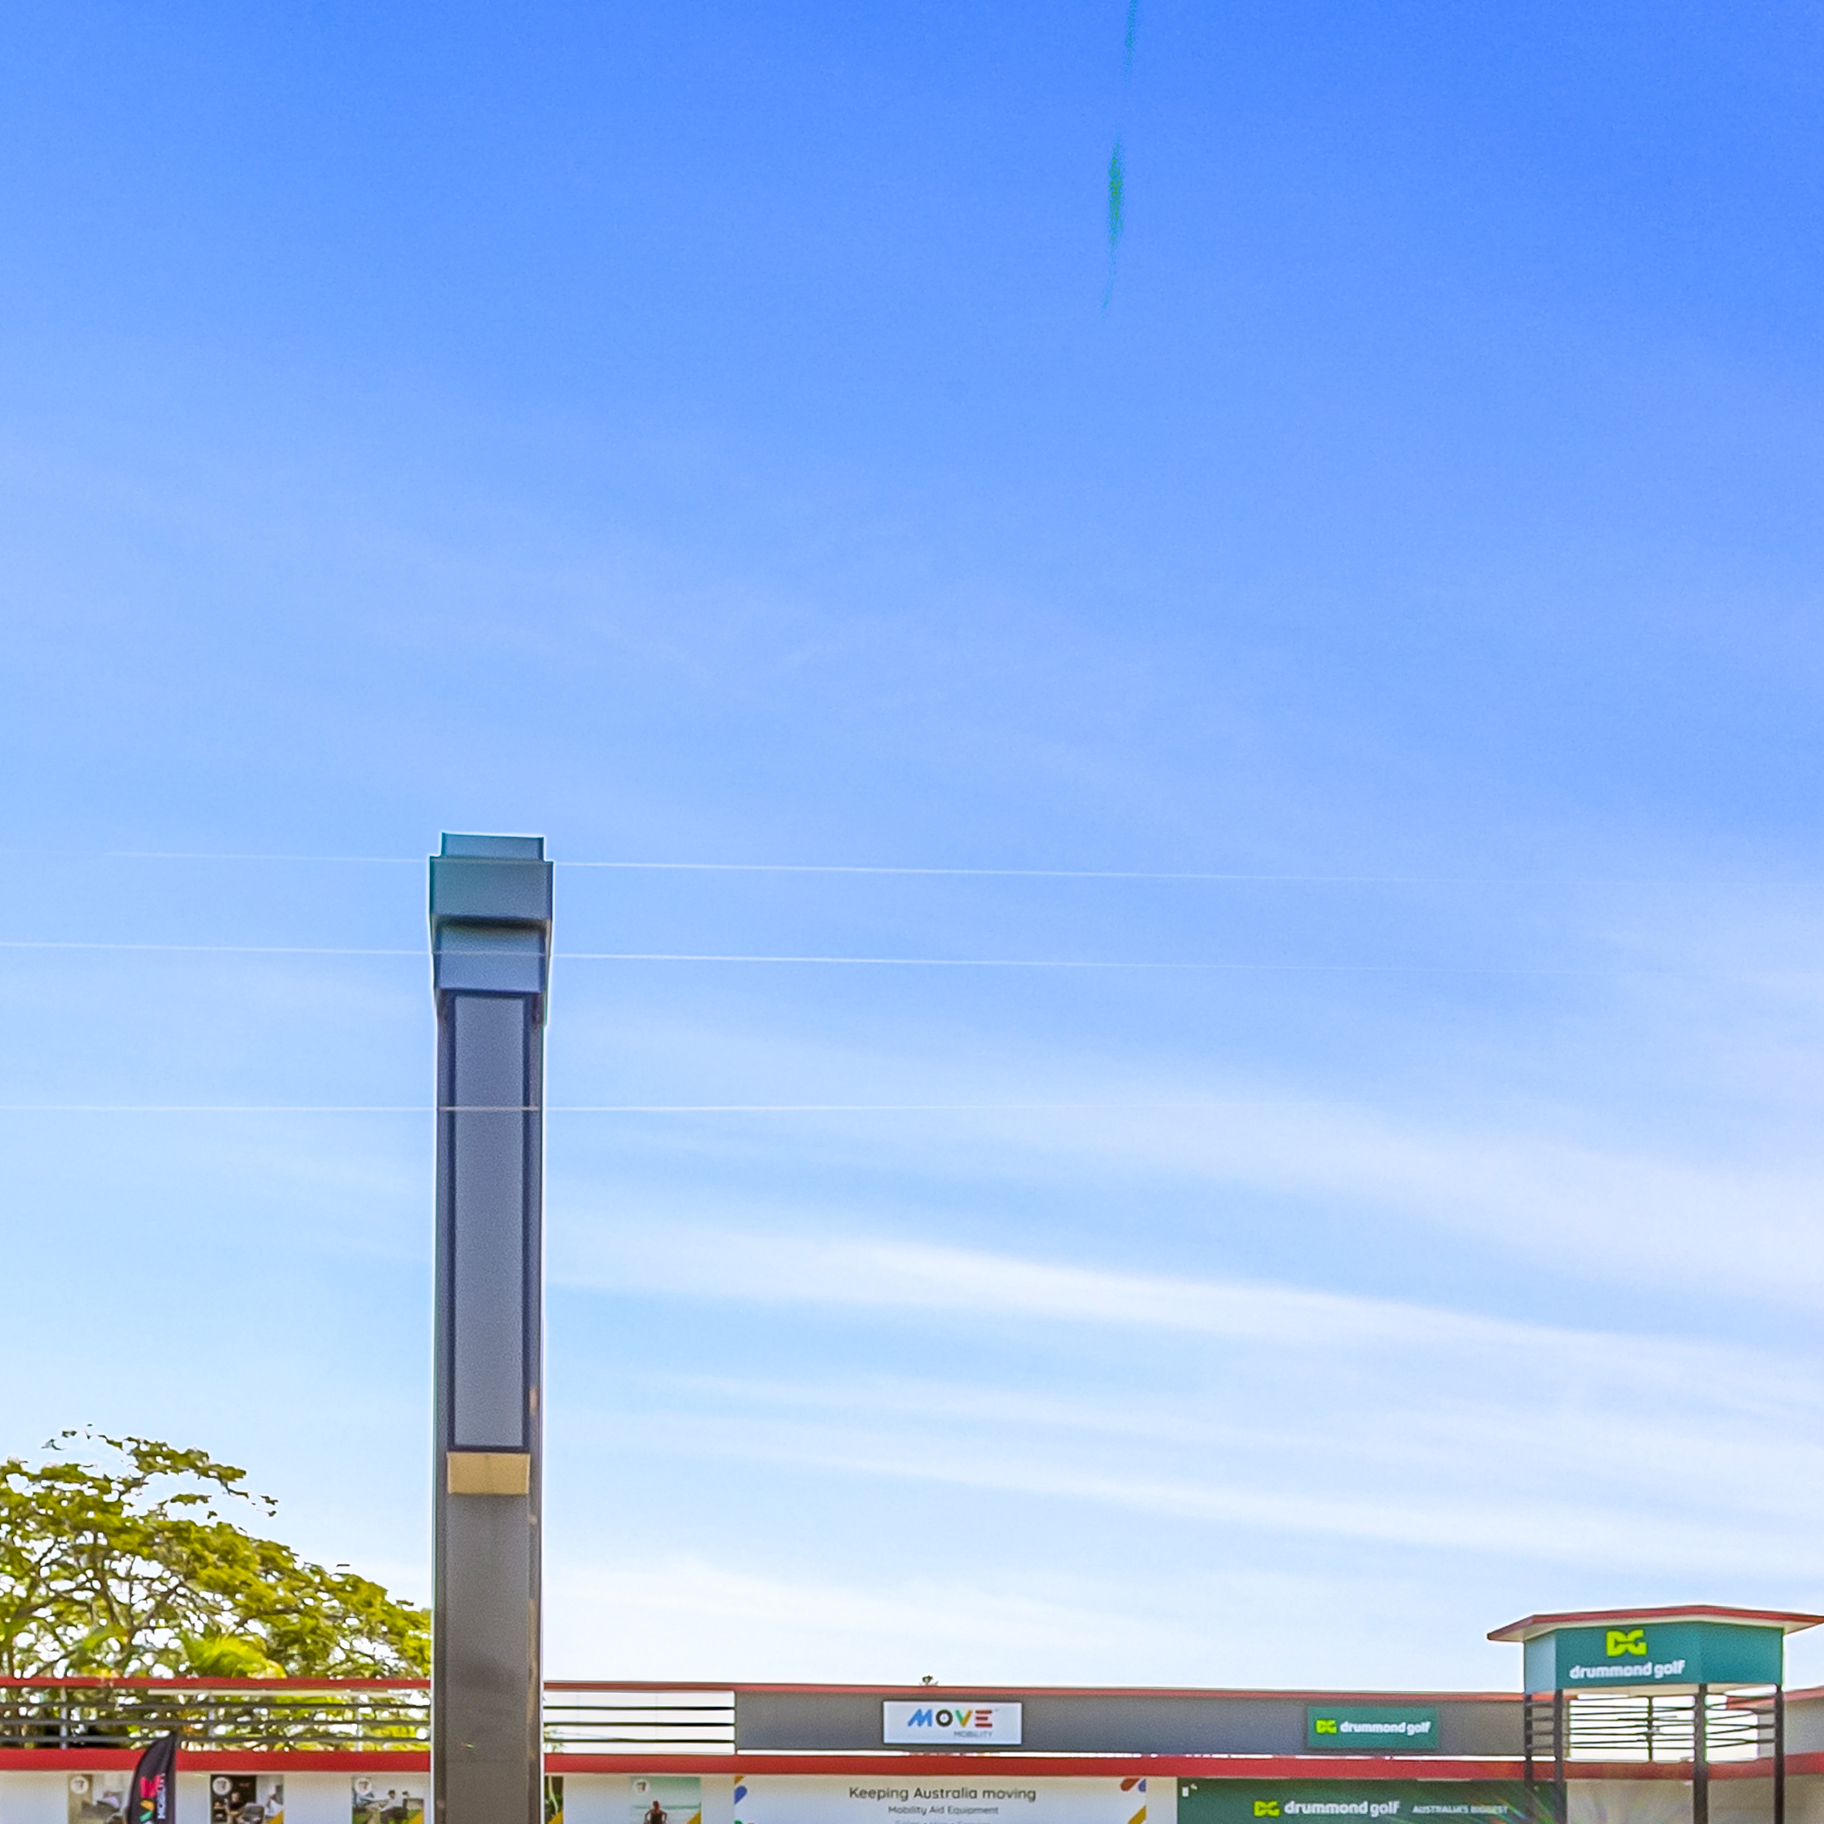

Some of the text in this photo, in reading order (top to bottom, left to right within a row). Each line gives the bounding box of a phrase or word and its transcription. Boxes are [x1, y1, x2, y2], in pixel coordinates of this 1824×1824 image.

[1606, 1629, 1647, 1656] DG
[1569, 1659, 1686, 1679] drummond golf
[907, 1708, 993, 1728] MOVE
[1339, 1721, 1406, 1733] drummond
[1407, 1721, 1431, 1736] golf
[849, 1787, 1037, 1802] Keeping Australia moving
[888, 1805, 999, 1816] Mobility Aid Equipment
[1284, 1801, 1368, 1814] drummond
[1370, 1801, 1400, 1817] golf
